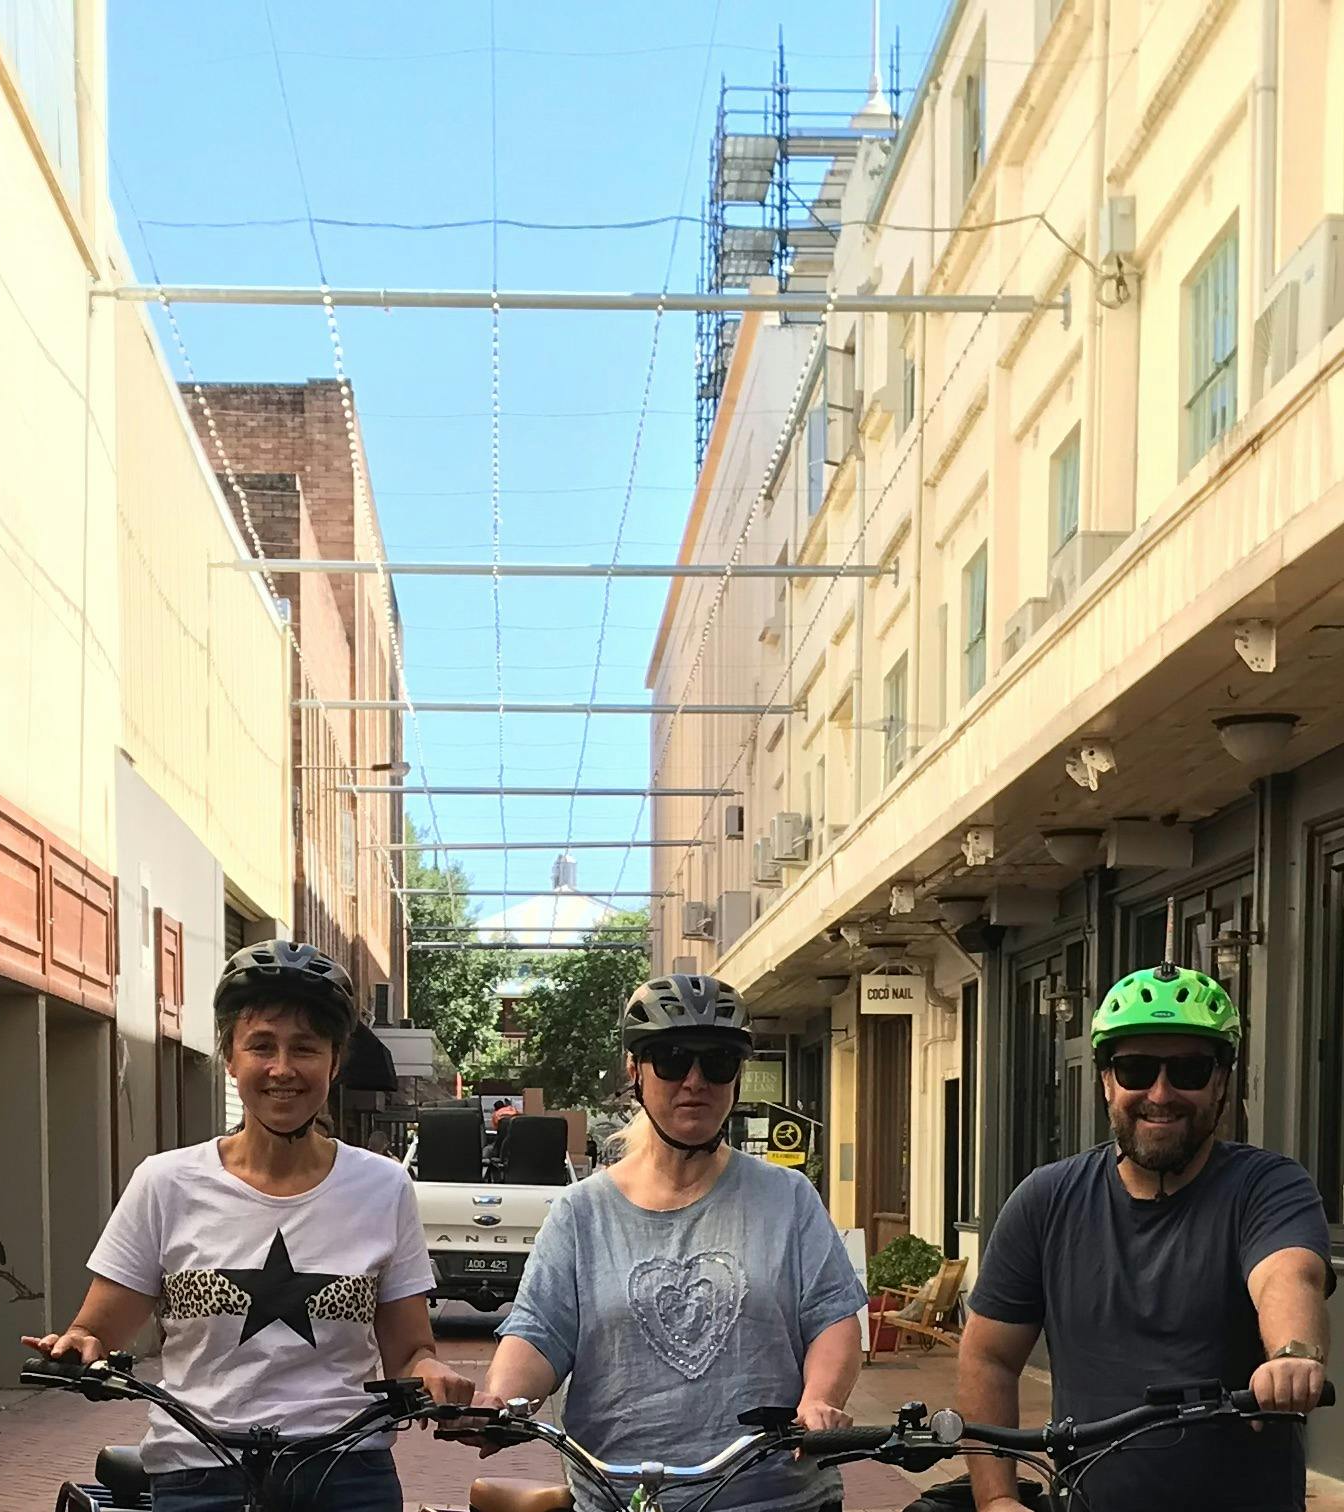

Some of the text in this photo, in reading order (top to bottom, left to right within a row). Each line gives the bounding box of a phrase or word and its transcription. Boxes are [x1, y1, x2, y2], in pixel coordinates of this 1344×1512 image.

[867, 987, 914, 1001] COCO NAIL
[435, 1234, 536, 1244] ANGE
